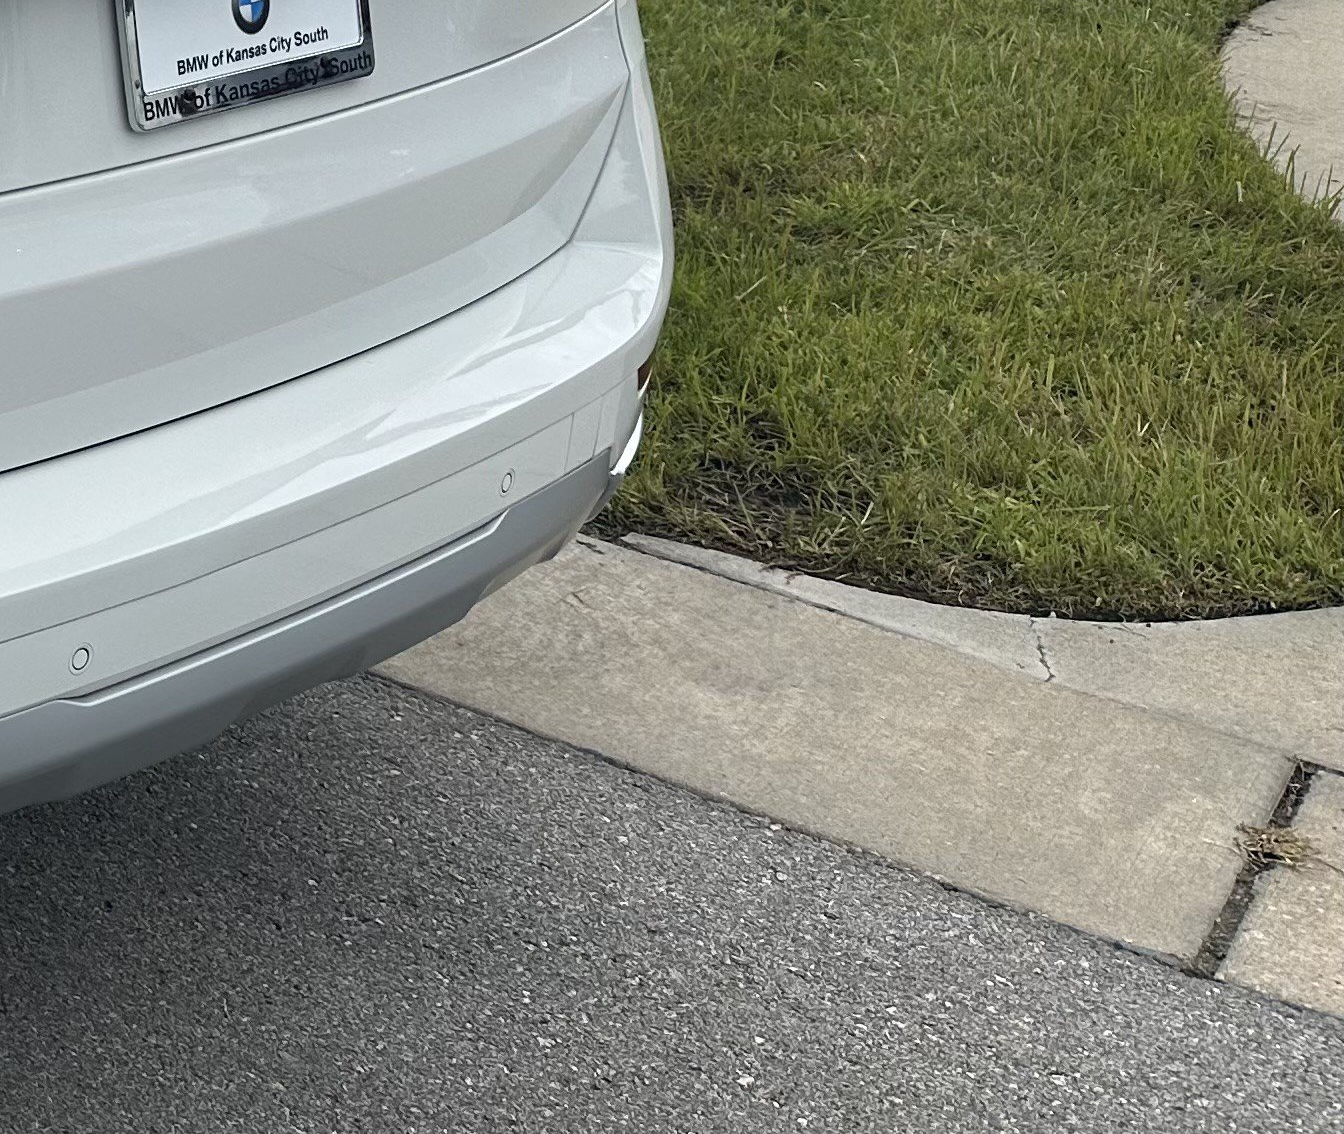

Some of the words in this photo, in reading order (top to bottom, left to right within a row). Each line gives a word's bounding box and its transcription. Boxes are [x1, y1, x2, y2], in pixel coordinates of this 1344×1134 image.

[177, 53, 210, 76] BMW
[212, 48, 225, 67] of
[226, 40, 268, 64] Kansas
[269, 35, 292, 58] City
[294, 26, 329, 47] South
[194, 88, 211, 110] of
[215, 74, 280, 104] Kansas
[285, 63, 320, 86] City
[327, 51, 373, 76] South
